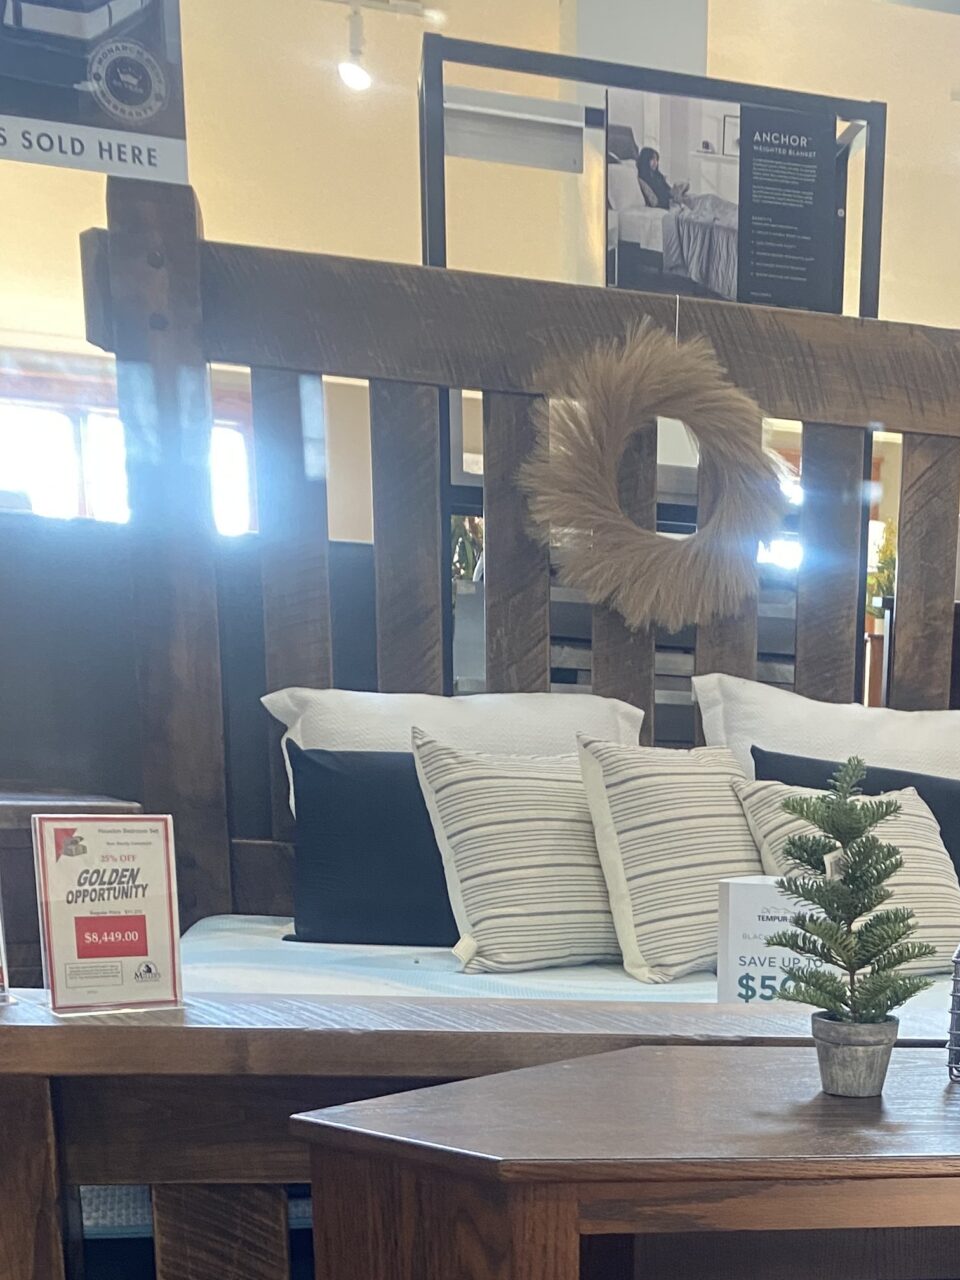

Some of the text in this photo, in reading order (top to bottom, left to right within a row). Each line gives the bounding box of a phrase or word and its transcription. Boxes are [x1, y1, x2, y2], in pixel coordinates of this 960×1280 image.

[753, 131, 808, 147] ANCHOR
[21, 129, 85, 156] SOLD
[98, 140, 158, 168] HERE
[753, 145, 816, 158] WEIGHTED BLANKET
[119, 854, 137, 862] OFF
[77, 867, 141, 888] GOLDEN
[65, 883, 149, 905] OPPORTUNITY
[84, 930, 139, 945] $8,449.00
[738, 955, 824, 969] SAVE UP TO
